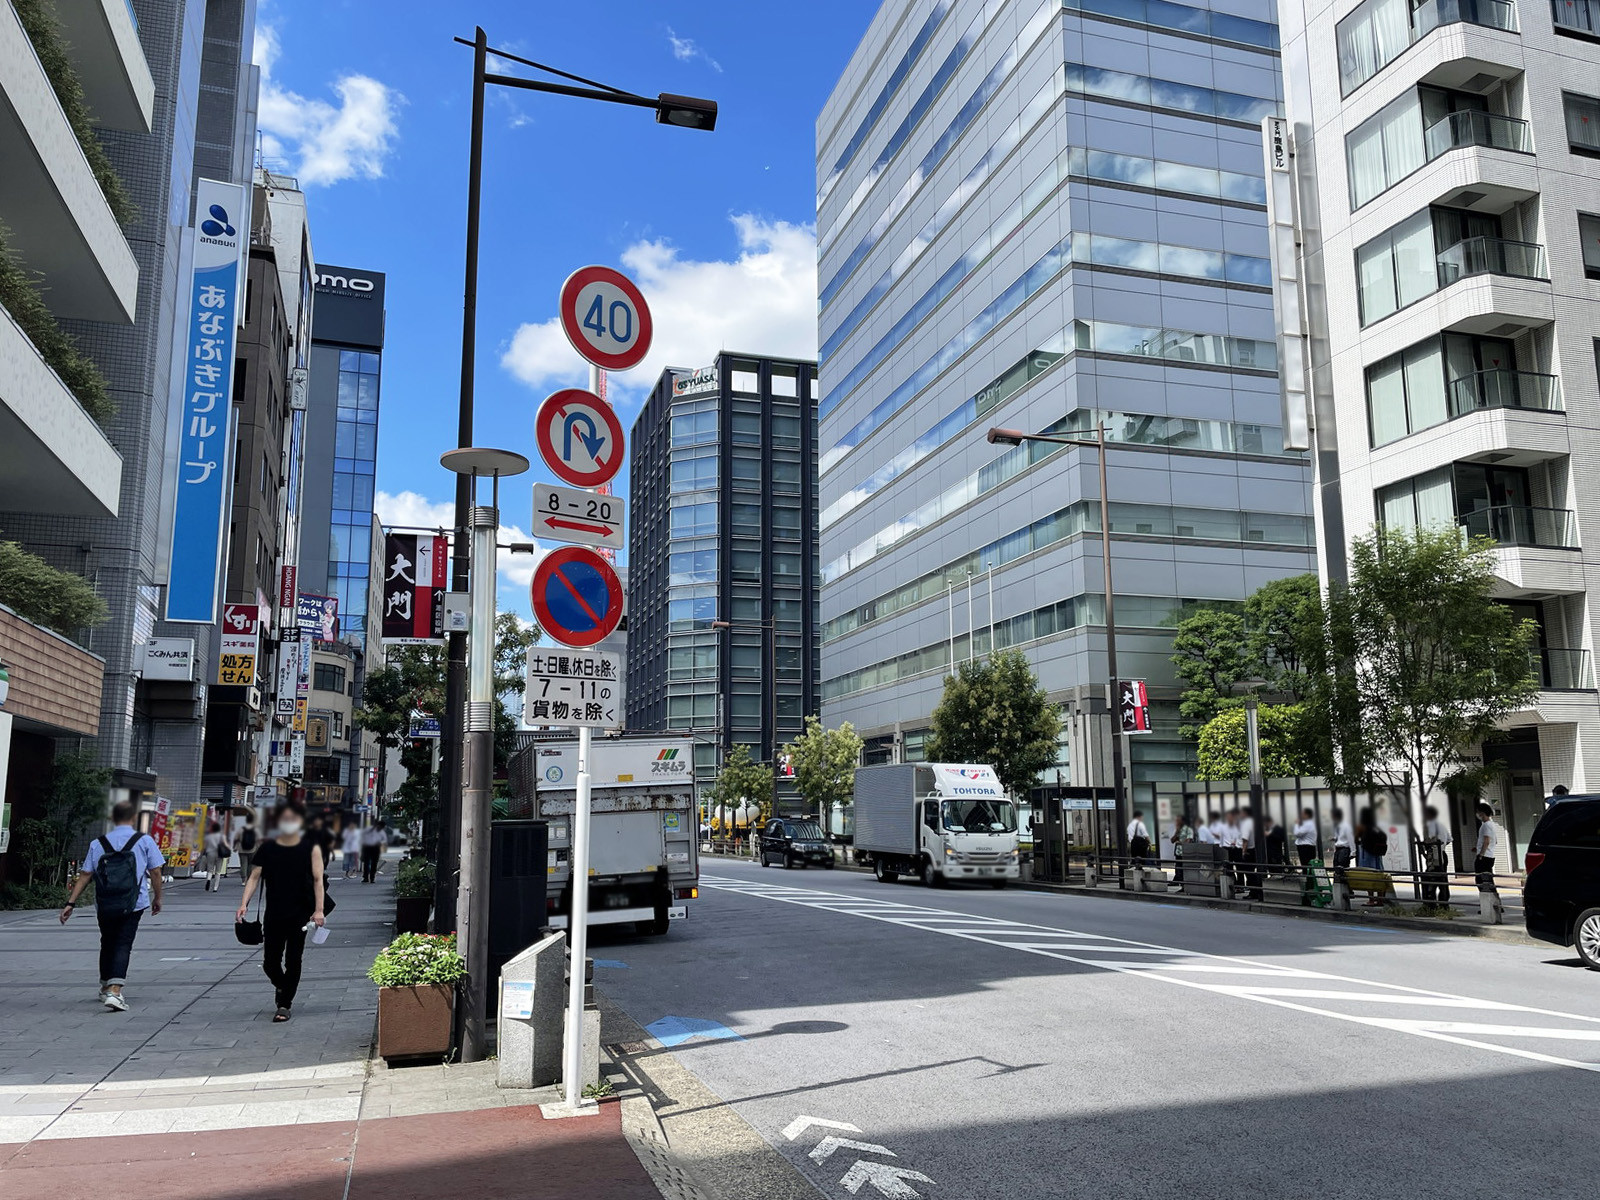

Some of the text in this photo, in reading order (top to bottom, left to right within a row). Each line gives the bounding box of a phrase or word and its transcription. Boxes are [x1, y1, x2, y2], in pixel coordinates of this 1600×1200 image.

[584, 294, 631, 343] 40
[186, 285, 227, 484] あなぶきグループ
[688, 374, 714, 386] YUASA
[385, 553, 415, 620] 大門
[225, 606, 257, 634] くすり
[148, 650, 188, 659] こくみん共済
[222, 654, 253, 669] 処方
[221, 670, 251, 684] せん
[532, 699, 614, 722] 貨物を除く
[1121, 691, 1136, 724] 大門
[651, 761, 686, 772] スギムラ
[953, 787, 996, 795] TOHTORA
